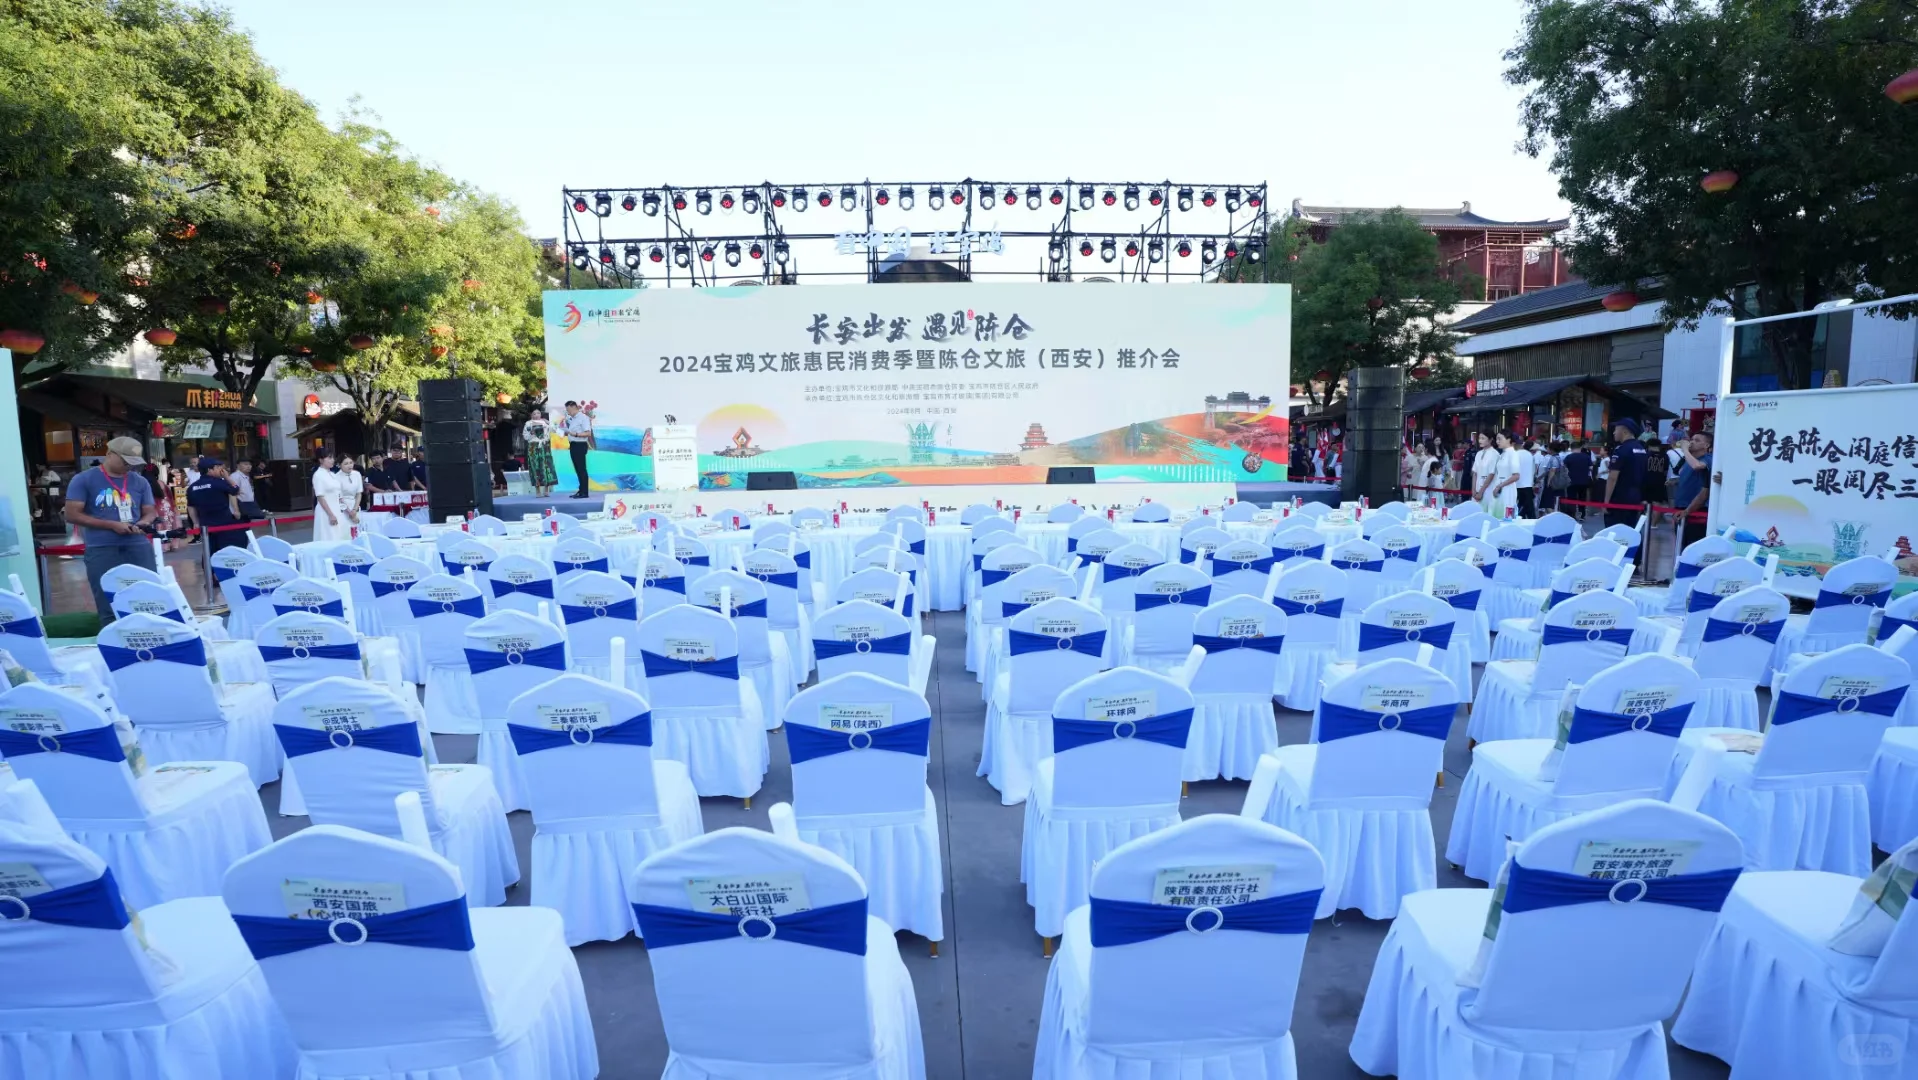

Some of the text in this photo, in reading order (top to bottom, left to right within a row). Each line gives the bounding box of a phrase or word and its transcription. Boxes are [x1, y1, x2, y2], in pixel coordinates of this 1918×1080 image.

[806, 309, 1035, 345] 长安出发 遇见陈仓
[659, 347, 1181, 374] 2024宝鸡文旅惠民消费季暨陈仓文旅（西安）推介会
[219, 391, 242, 400] ZHUA
[219, 400, 242, 409] BANG
[1748, 427, 1918, 468] 好看陈仓闲庭信
[1834, 687, 1868, 696] 人民日报
[1380, 699, 1411, 708] 华商网
[1106, 706, 1137, 718] 环球网
[550, 714, 598, 725] 三秦都市报
[831, 719, 882, 729] 网易(陕西)
[1589, 868, 1669, 880] 有限责任公司
[1164, 883, 1260, 896] 陕西秦旅旅行社
[312, 898, 378, 912] 西安国旅
[709, 892, 790, 907] 太白山国际
[1169, 893, 1251, 906] 有限责任公司
[730, 905, 777, 917] 旅行社
